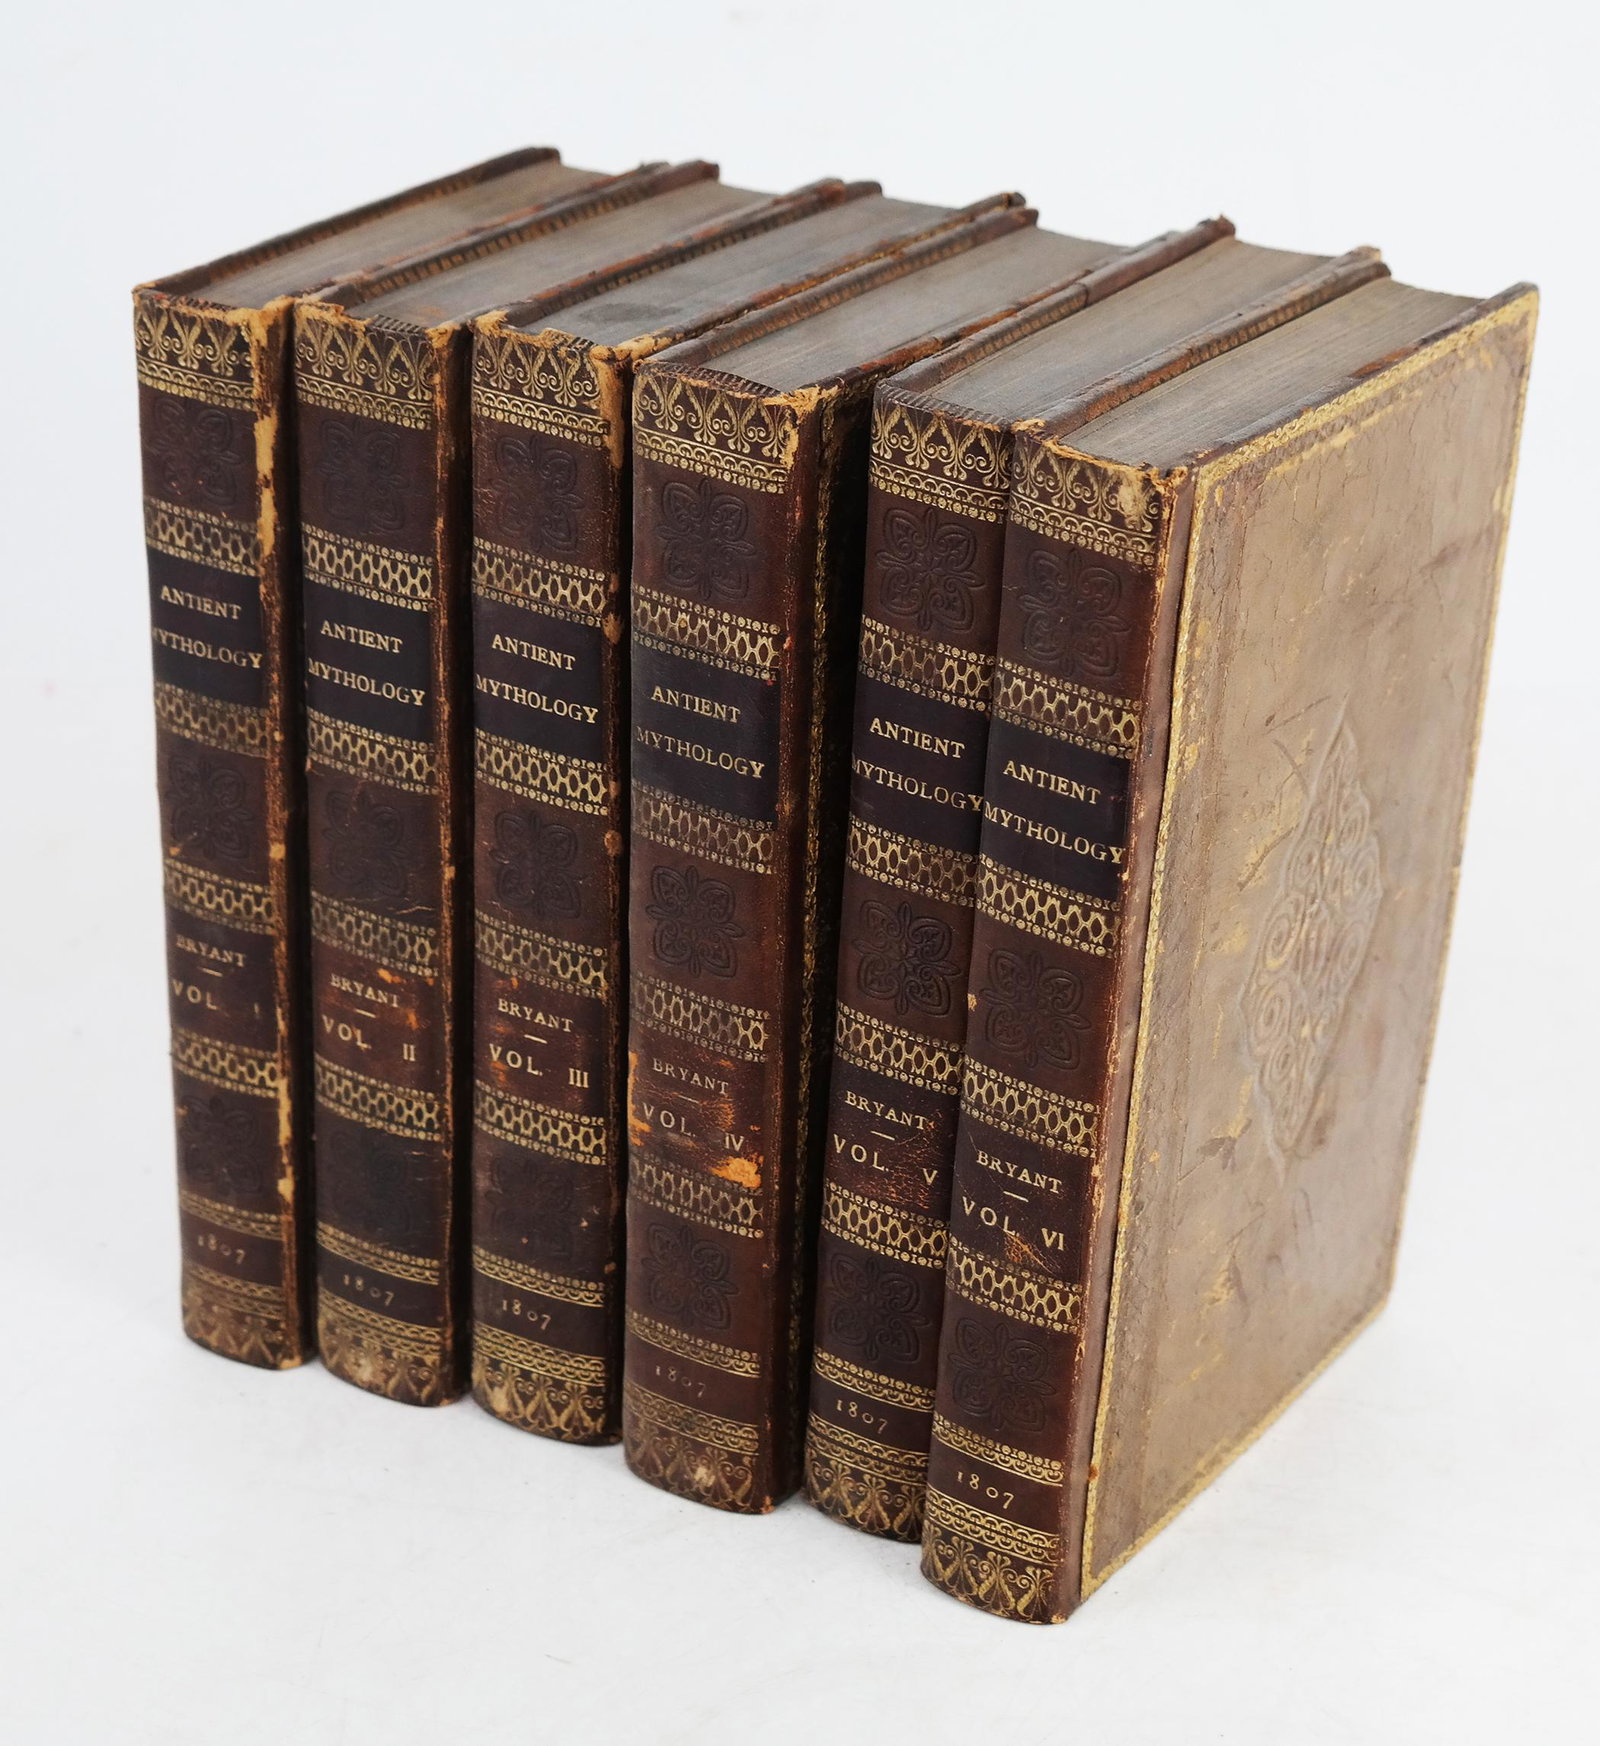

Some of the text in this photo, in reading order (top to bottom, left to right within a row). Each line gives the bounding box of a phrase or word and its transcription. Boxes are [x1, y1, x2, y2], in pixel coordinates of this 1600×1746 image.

[160, 585, 241, 620] ANTIENT
[320, 619, 403, 654] ANTIENT
[492, 633, 576, 671] ANTIENT
[308, 657, 426, 706] MYTHOLOGY
[476, 674, 599, 724] MYTHOLOGY
[651, 685, 740, 723] ANTIENT
[636, 726, 765, 778] MYTHOLOGY
[869, 717, 965, 759] ANTIENT
[851, 756, 984, 812] MYTHOLOGY
[1003, 760, 1101, 805] ANTIENT
[984, 801, 1126, 865] MYTHOLOGY
[176, 934, 246, 967] BRYANT
[330, 973, 400, 1008] BRYANT
[498, 998, 574, 1033] BRYANT
[402, 1043, 416, 1062] II
[489, 1043, 589, 1089] VOL. III
[652, 1057, 729, 1095] BRYANT
[642, 1102, 745, 1151] VOL. IV
[844, 1090, 928, 1130] BRYANT
[833, 1134, 938, 1186] VOL. V
[976, 1150, 1062, 1194] BRYANT
[962, 1196, 1065, 1251] VOL. VI
[198, 1235, 246, 1264] 1807
[343, 1273, 395, 1306] 1807
[502, 1299, 551, 1331] 1807
[655, 1364, 706, 1398] 1807
[836, 1400, 888, 1434] 1807
[957, 1471, 1014, 1510] 1807
